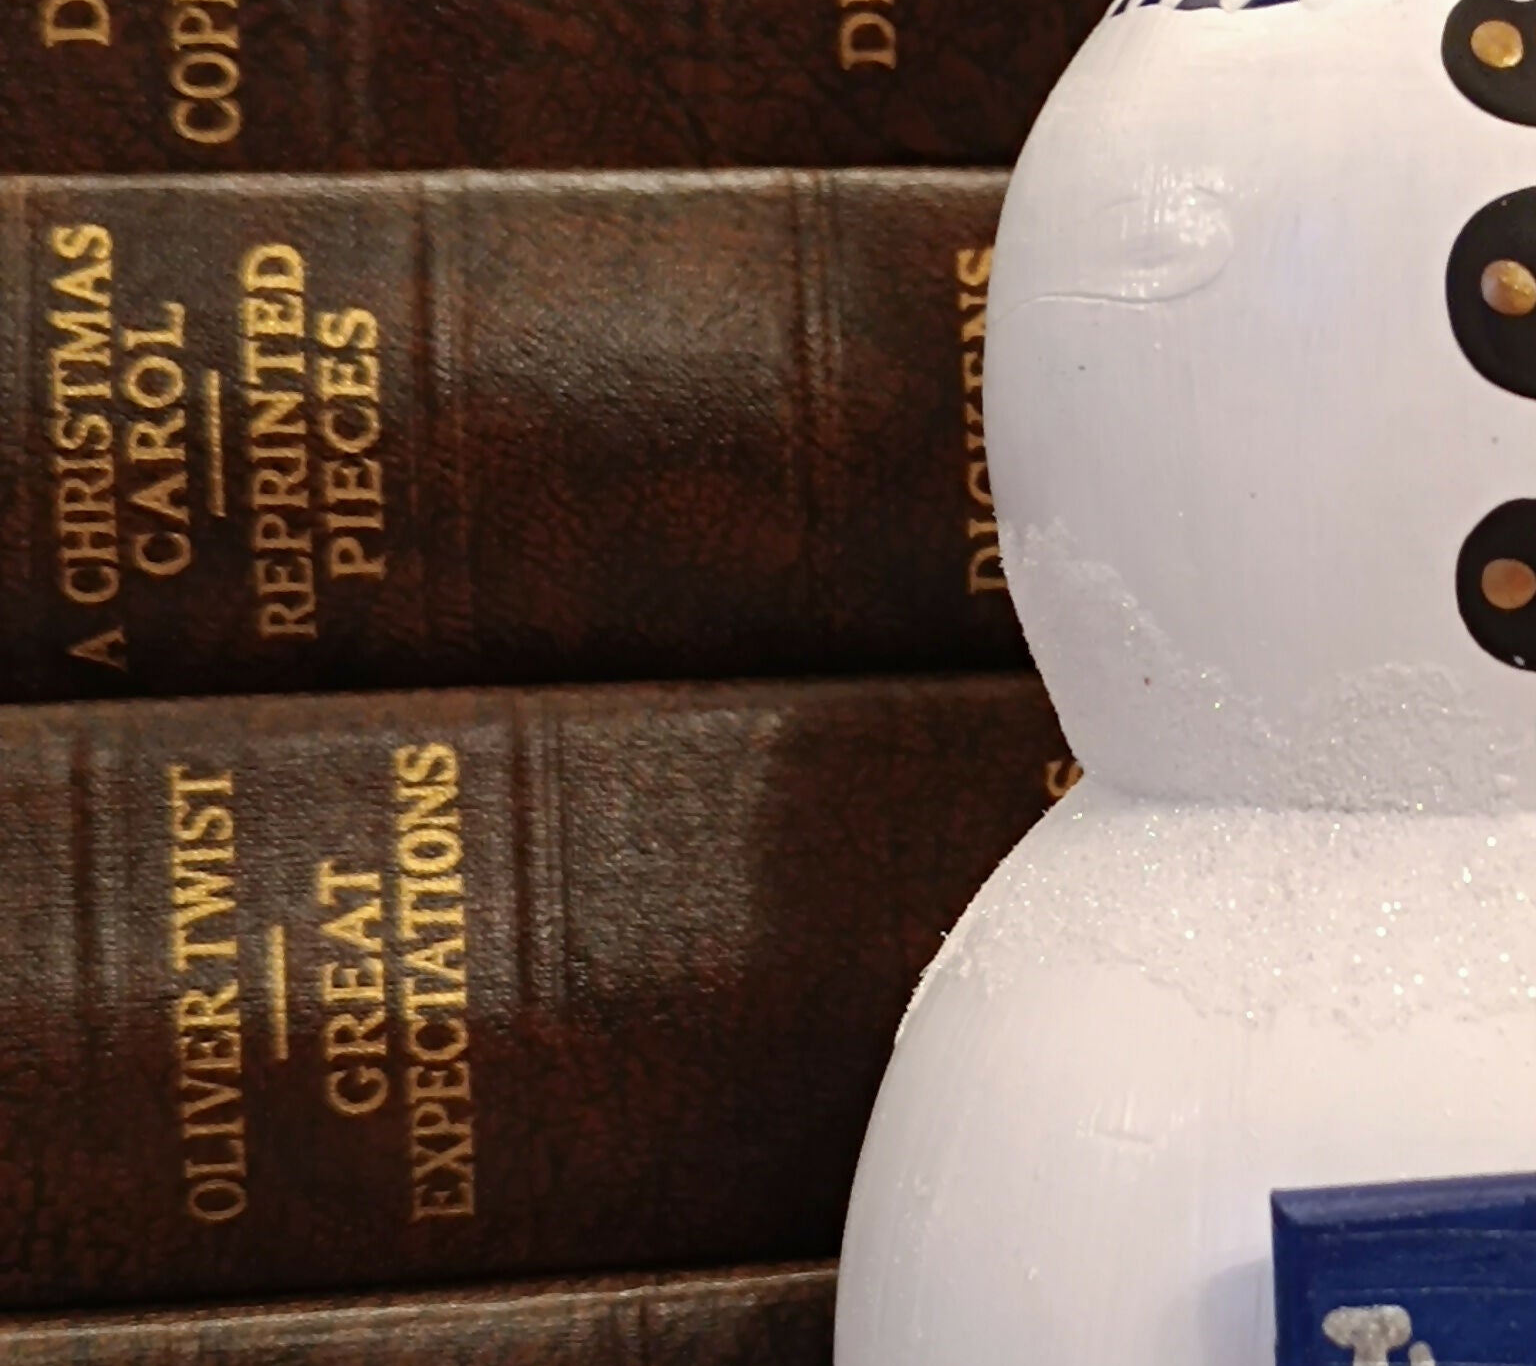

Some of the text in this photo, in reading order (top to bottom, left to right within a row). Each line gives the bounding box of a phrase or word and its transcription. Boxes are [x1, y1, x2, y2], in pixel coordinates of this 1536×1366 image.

[50, 224, 127, 672] A CHRISTMAS
[122, 301, 190, 576] CAROL
[241, 243, 318, 641] REPRINTED
[320, 307, 384, 580] PIECES
[168, 765, 247, 1221] OLIVER TWIST
[318, 859, 388, 1114] GREAT
[396, 741, 475, 1223] EXPECTATIONS
